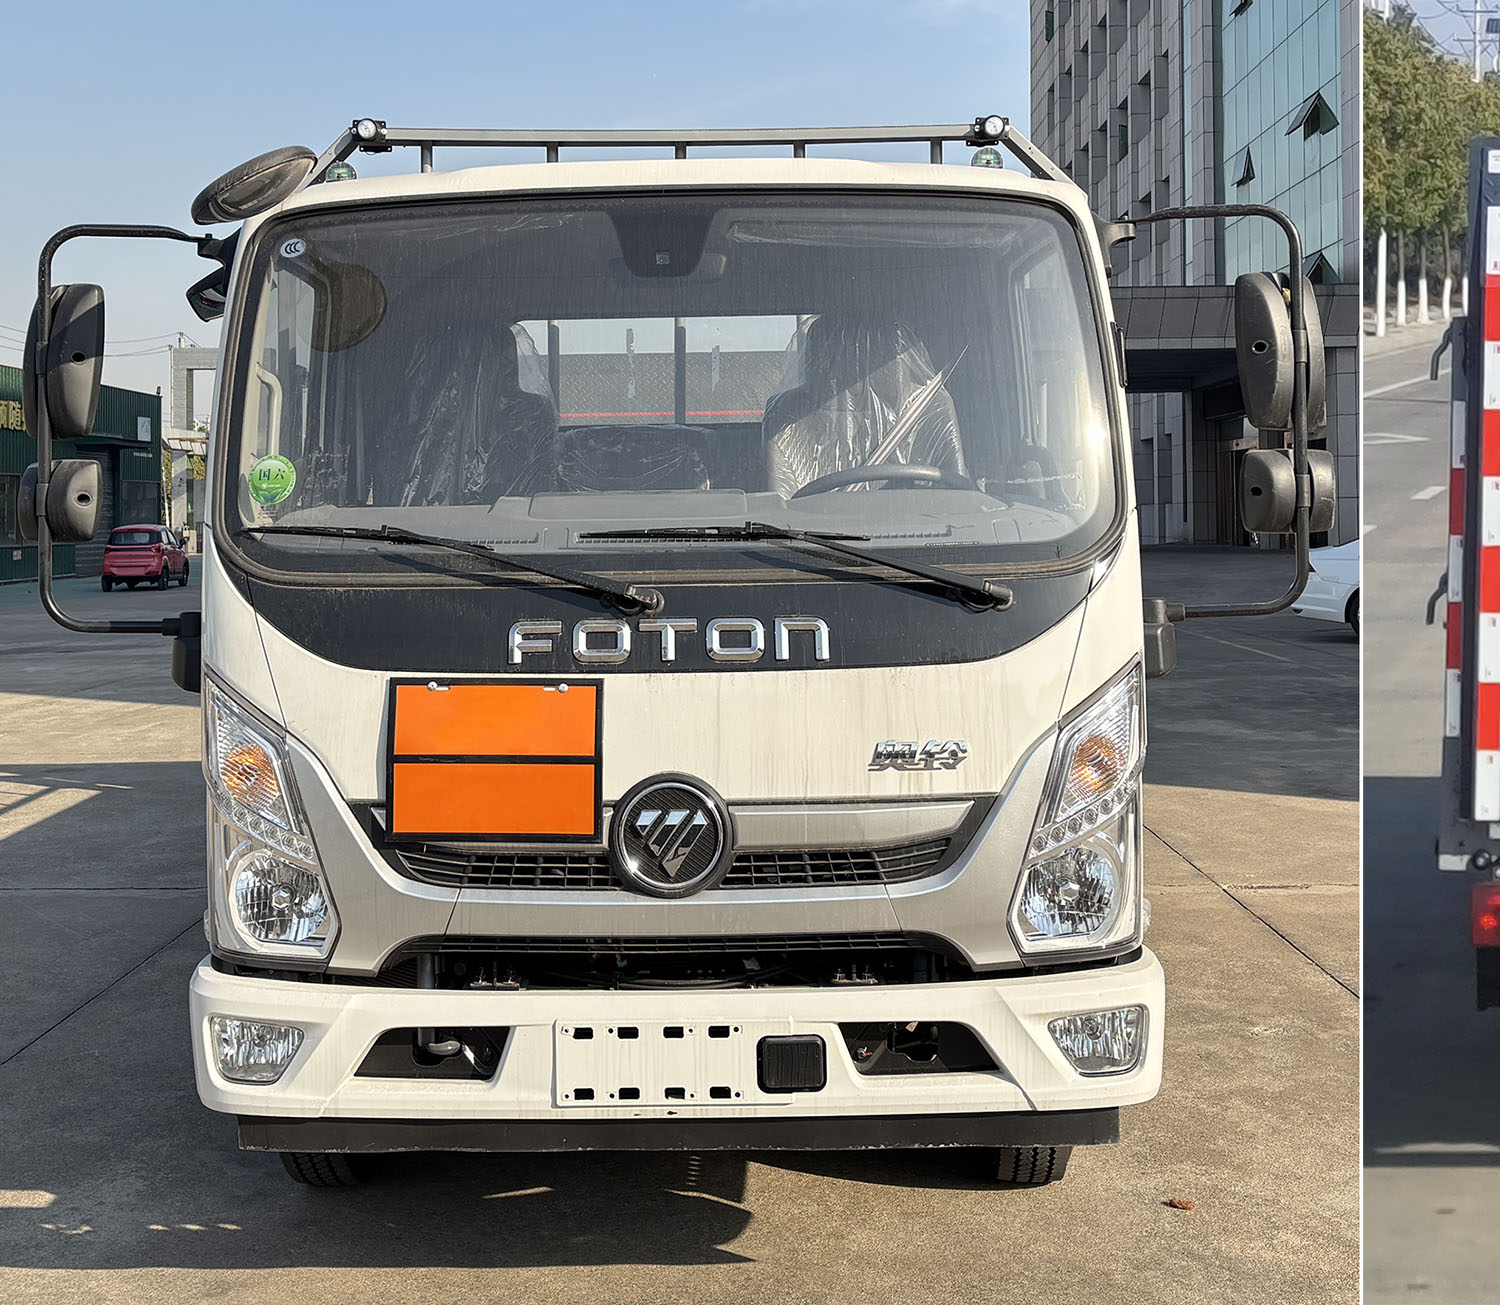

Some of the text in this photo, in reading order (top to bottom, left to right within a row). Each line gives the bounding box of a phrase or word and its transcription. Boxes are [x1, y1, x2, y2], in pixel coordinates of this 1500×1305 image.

[258, 468, 286, 481] 国六
[508, 617, 830, 664] FOTON
[867, 740, 968, 772] 奥铃
